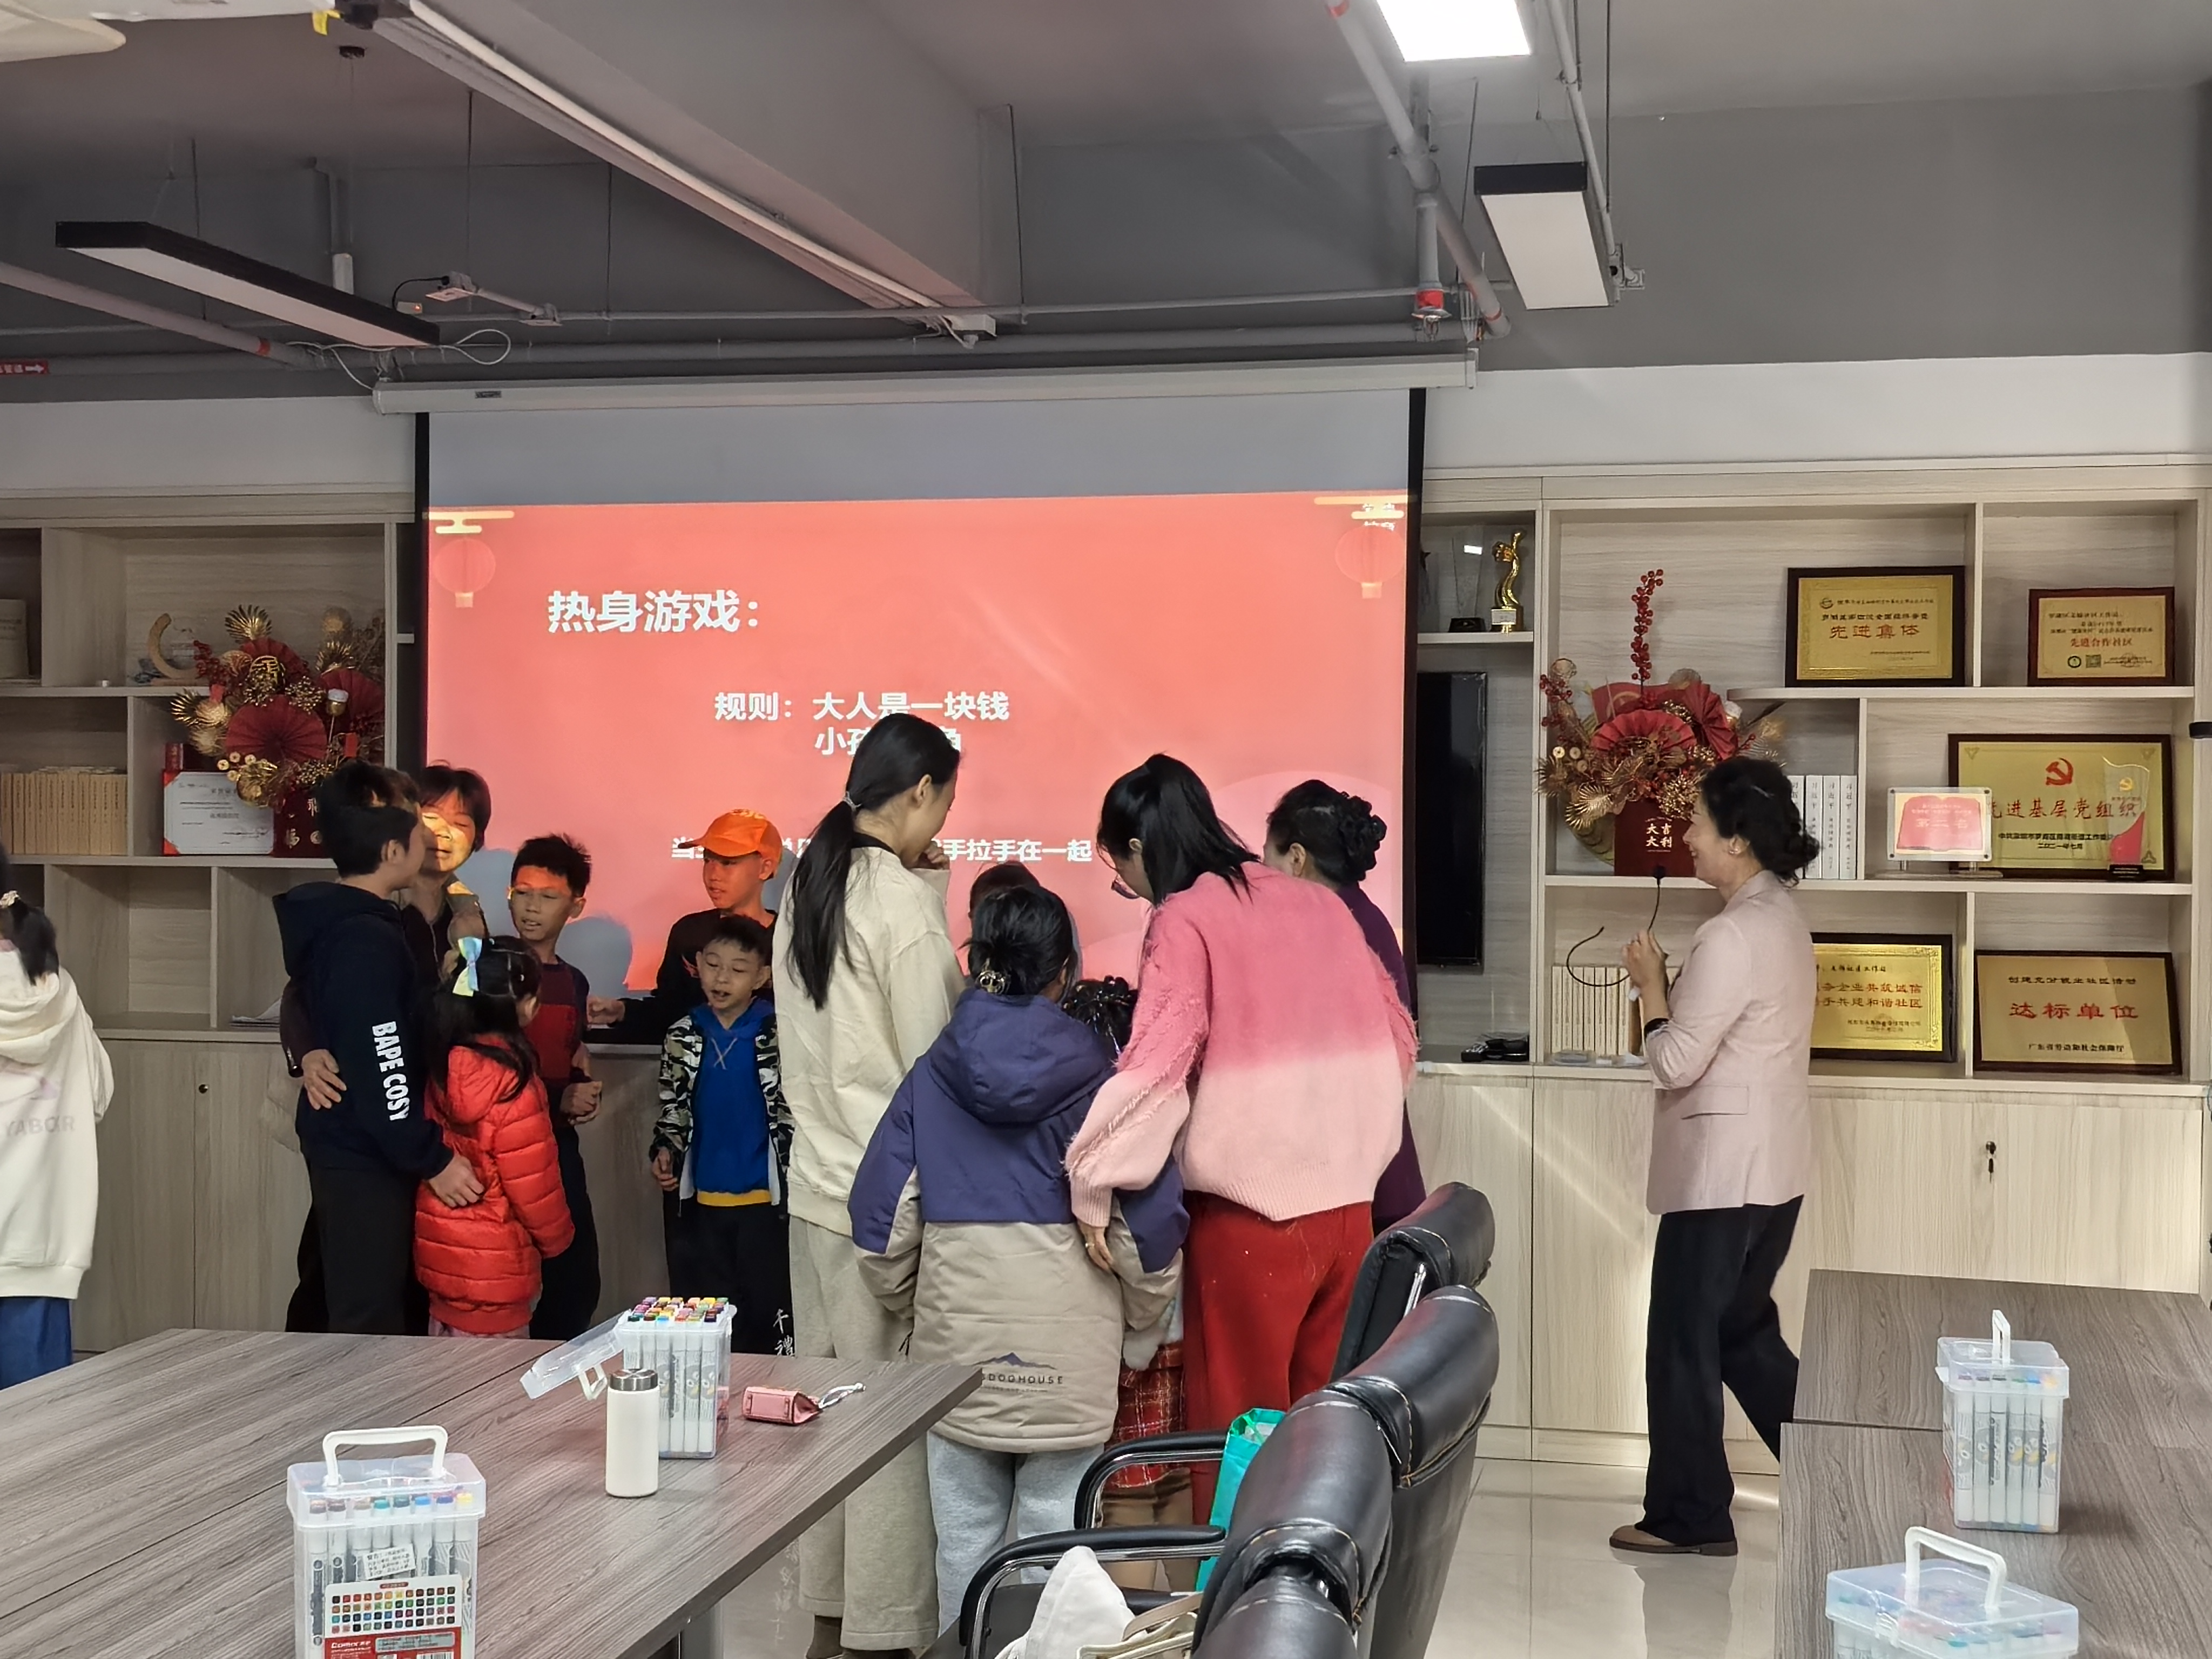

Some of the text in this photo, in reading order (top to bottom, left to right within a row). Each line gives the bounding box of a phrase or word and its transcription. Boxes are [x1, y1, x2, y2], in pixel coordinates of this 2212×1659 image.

[1646, 822, 1672, 835] 大吉
[2009, 1001, 2139, 1020] 达标单位
[372, 1021, 410, 1121] BAPE COSY
